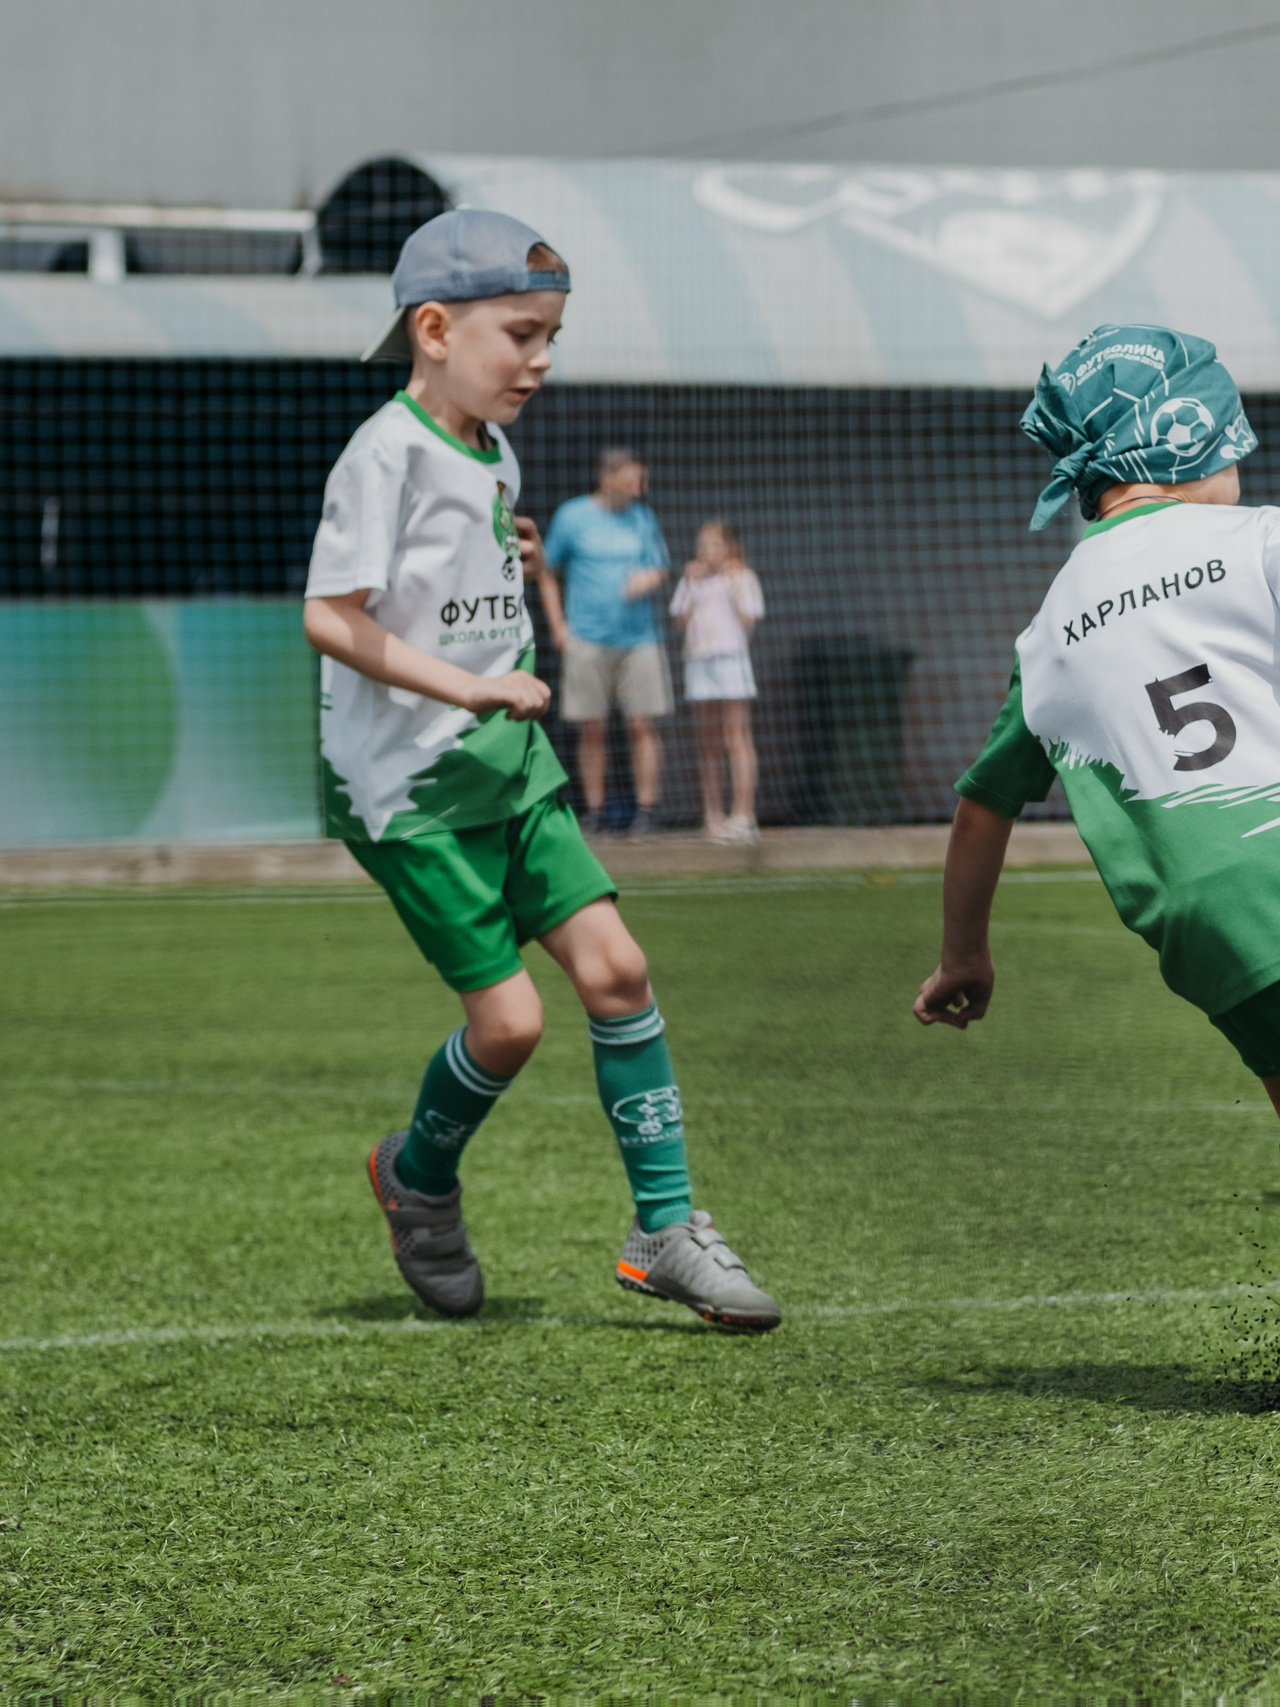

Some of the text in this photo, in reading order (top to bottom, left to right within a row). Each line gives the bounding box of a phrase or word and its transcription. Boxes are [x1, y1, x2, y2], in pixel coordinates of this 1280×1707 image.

[441, 595, 523, 627] ФУТБ
[1062, 558, 1228, 647] ХАРЛАНОВ
[439, 630, 486, 646] ШКОЛА
[1144, 663, 1237, 772] 5
